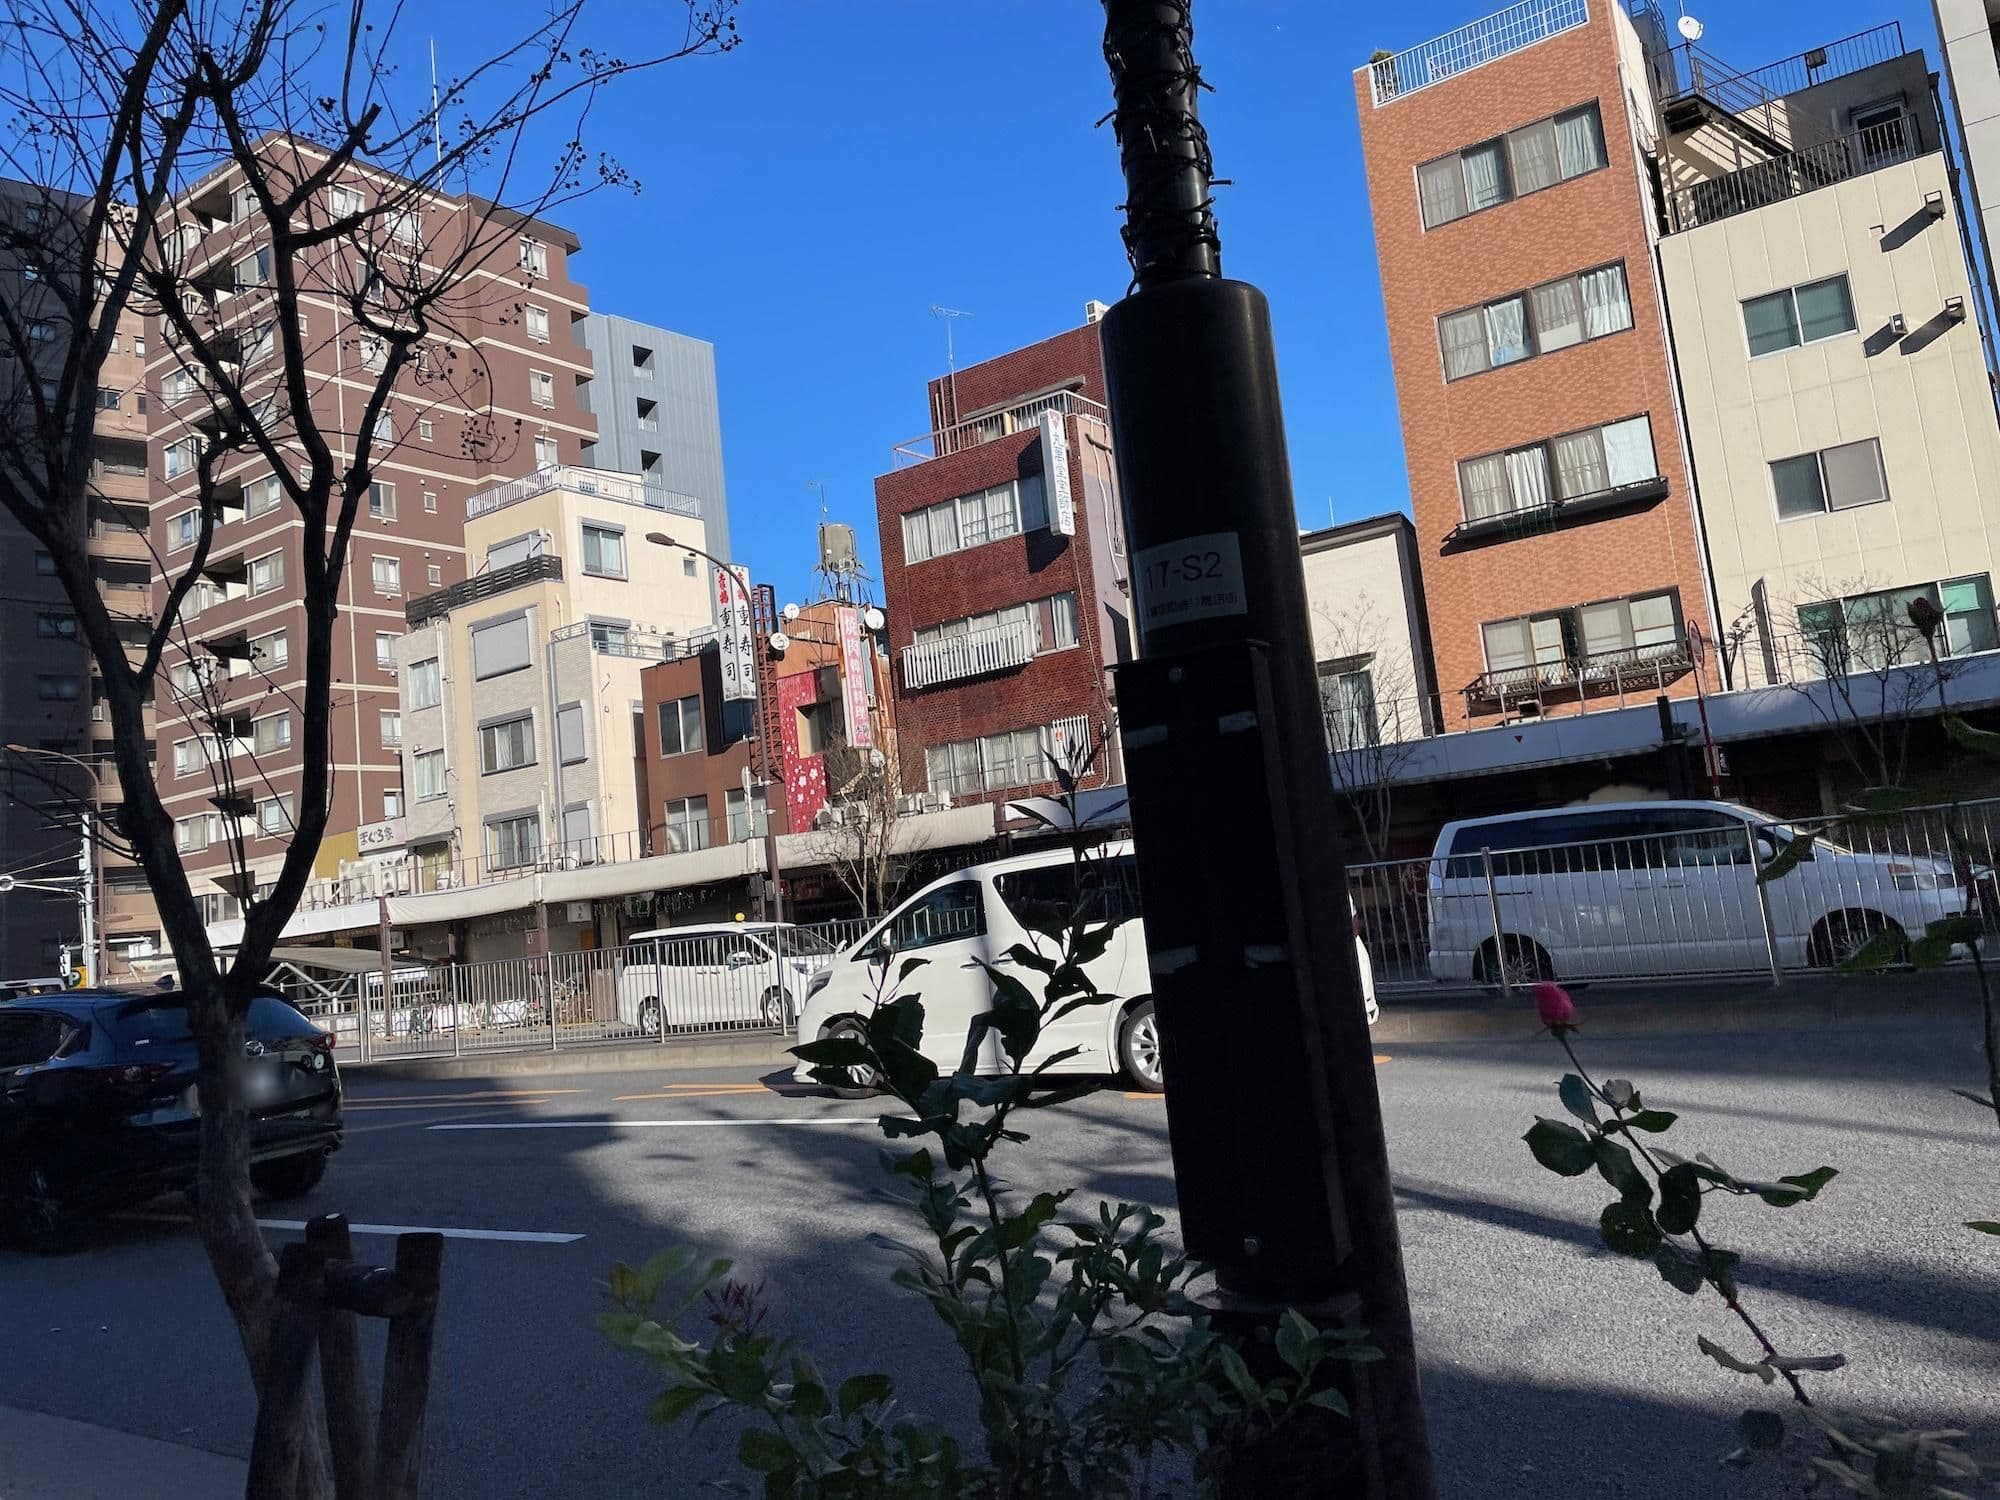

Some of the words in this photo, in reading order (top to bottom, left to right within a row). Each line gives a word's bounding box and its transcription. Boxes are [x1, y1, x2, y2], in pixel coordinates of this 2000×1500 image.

[1146, 552, 1222, 592] 17-S2
[720, 607, 736, 681] 重寿司
[737, 605, 755, 682] 重寿司
